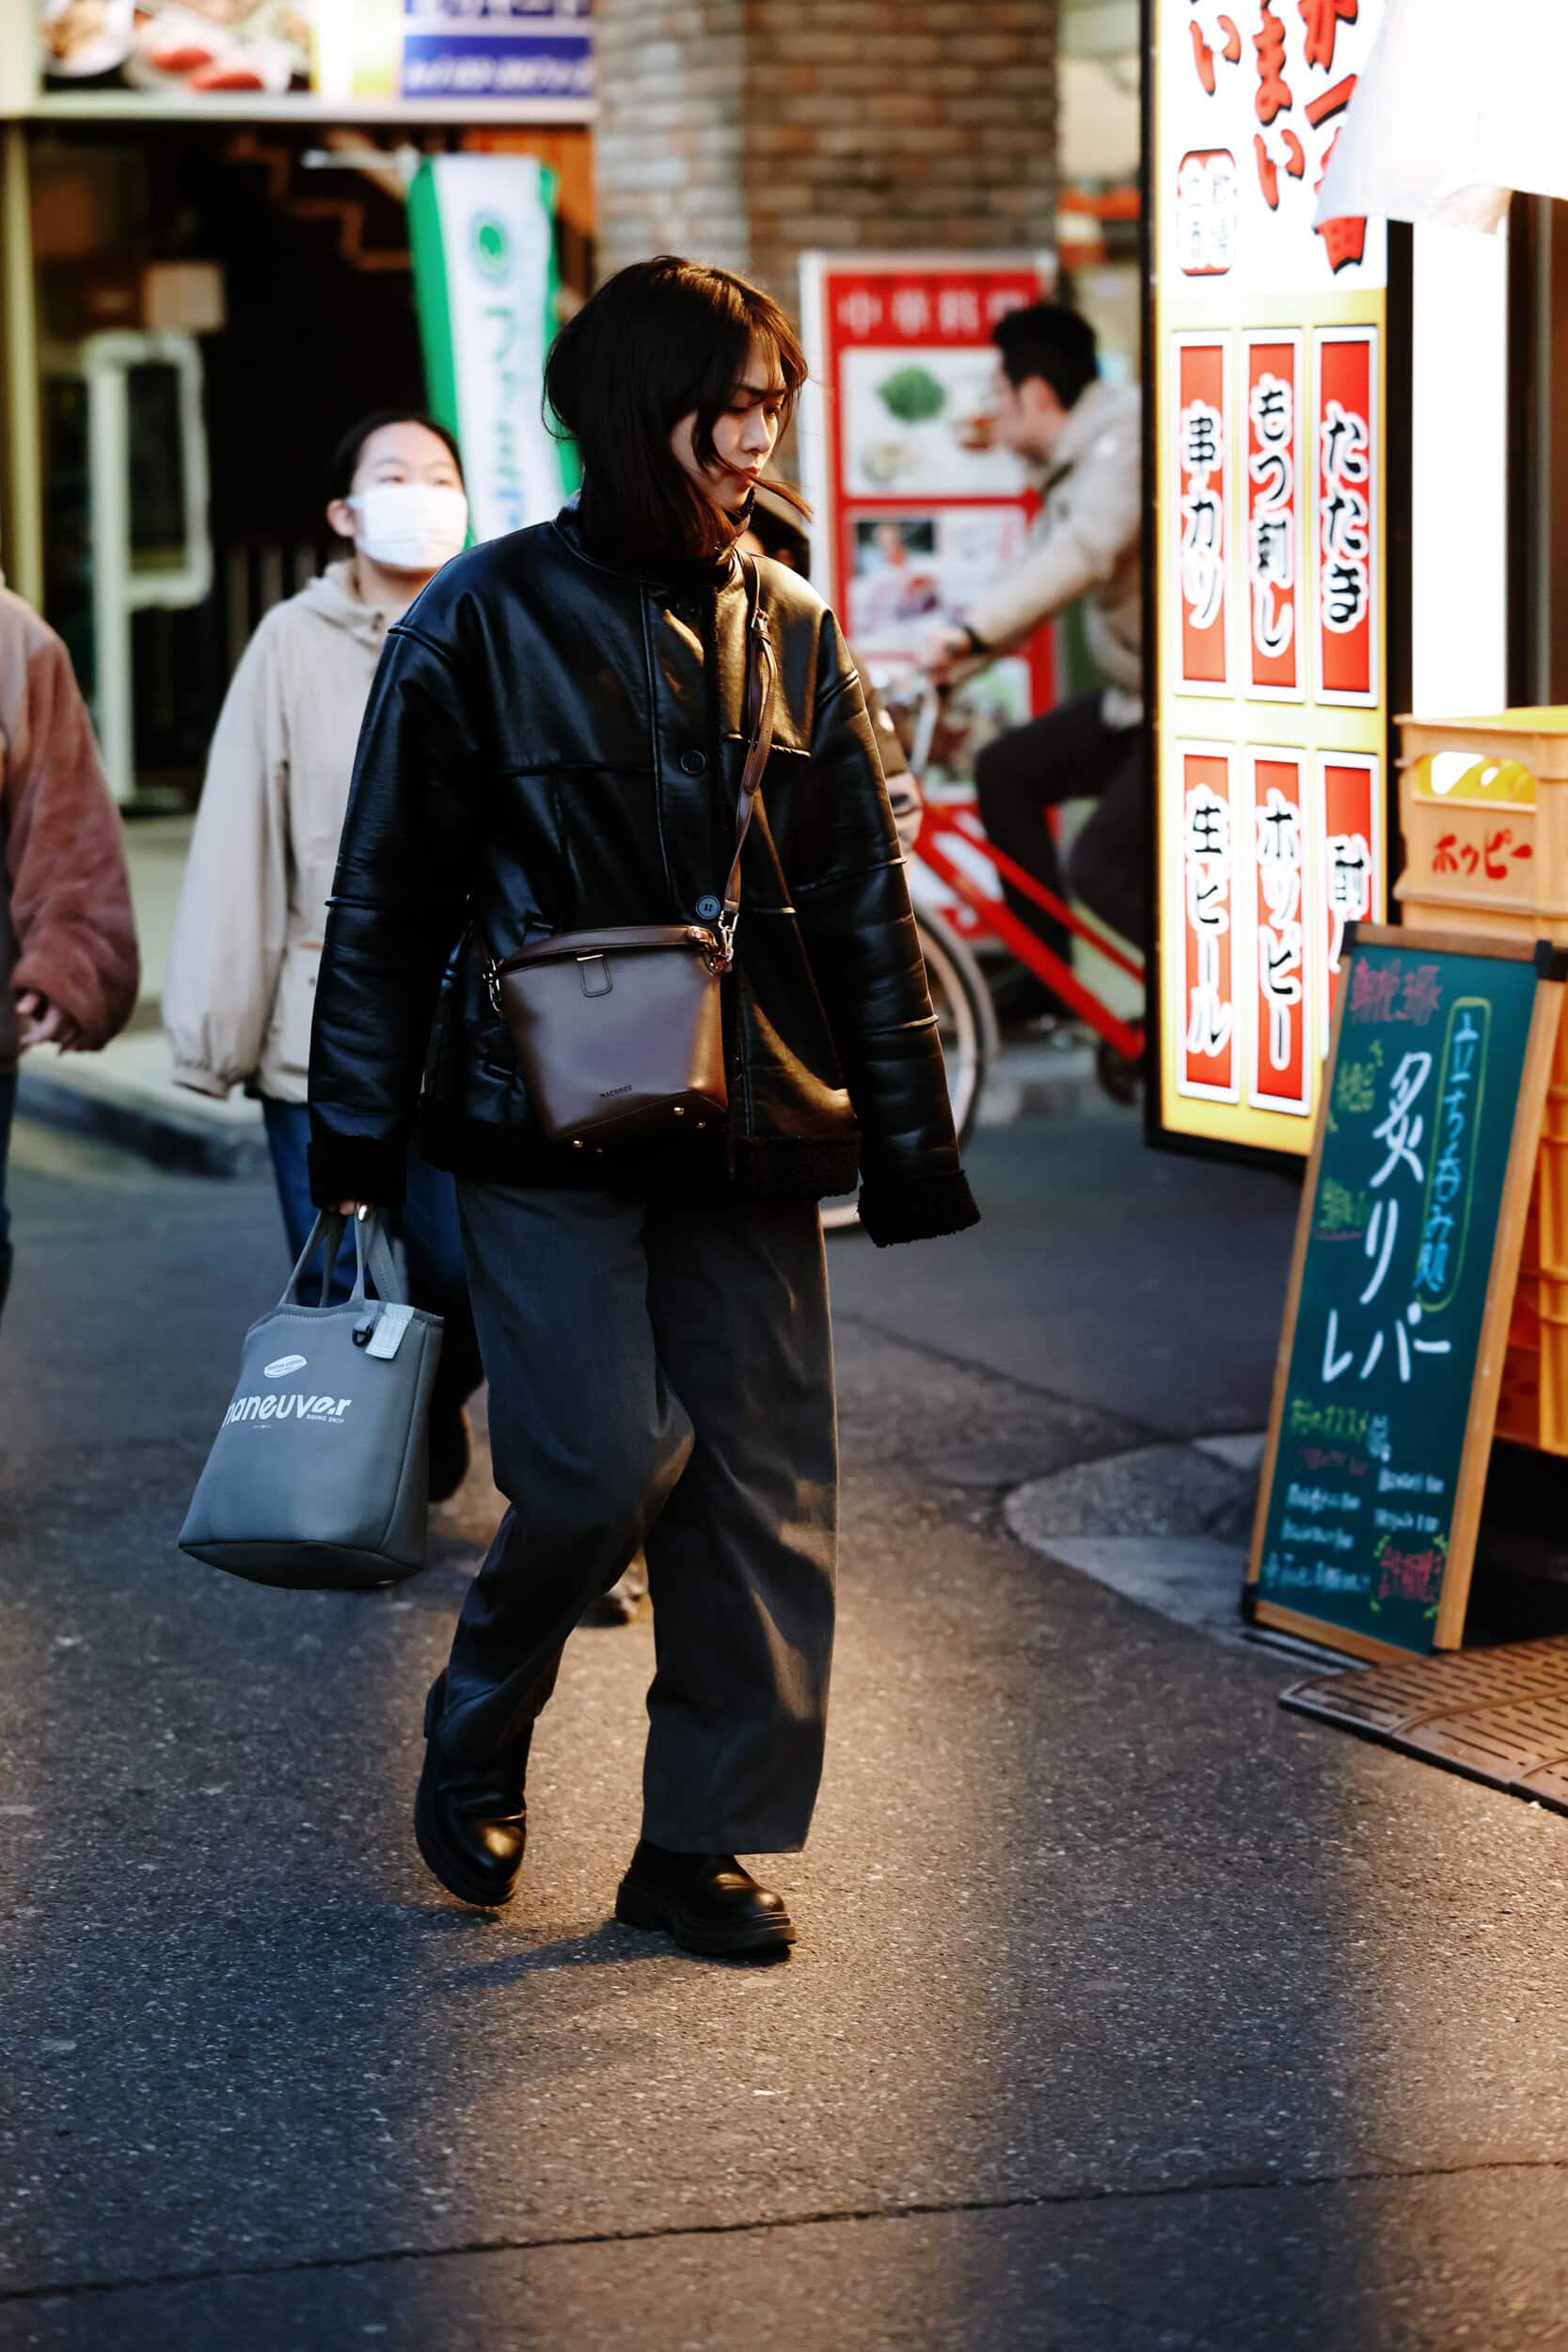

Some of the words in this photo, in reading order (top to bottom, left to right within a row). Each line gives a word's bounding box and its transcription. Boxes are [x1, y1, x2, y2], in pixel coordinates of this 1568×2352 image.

[1324, 408, 1367, 629] たたき
[1187, 790, 1228, 1051] 生ビール
[1432, 828, 1533, 880] ホッピー
